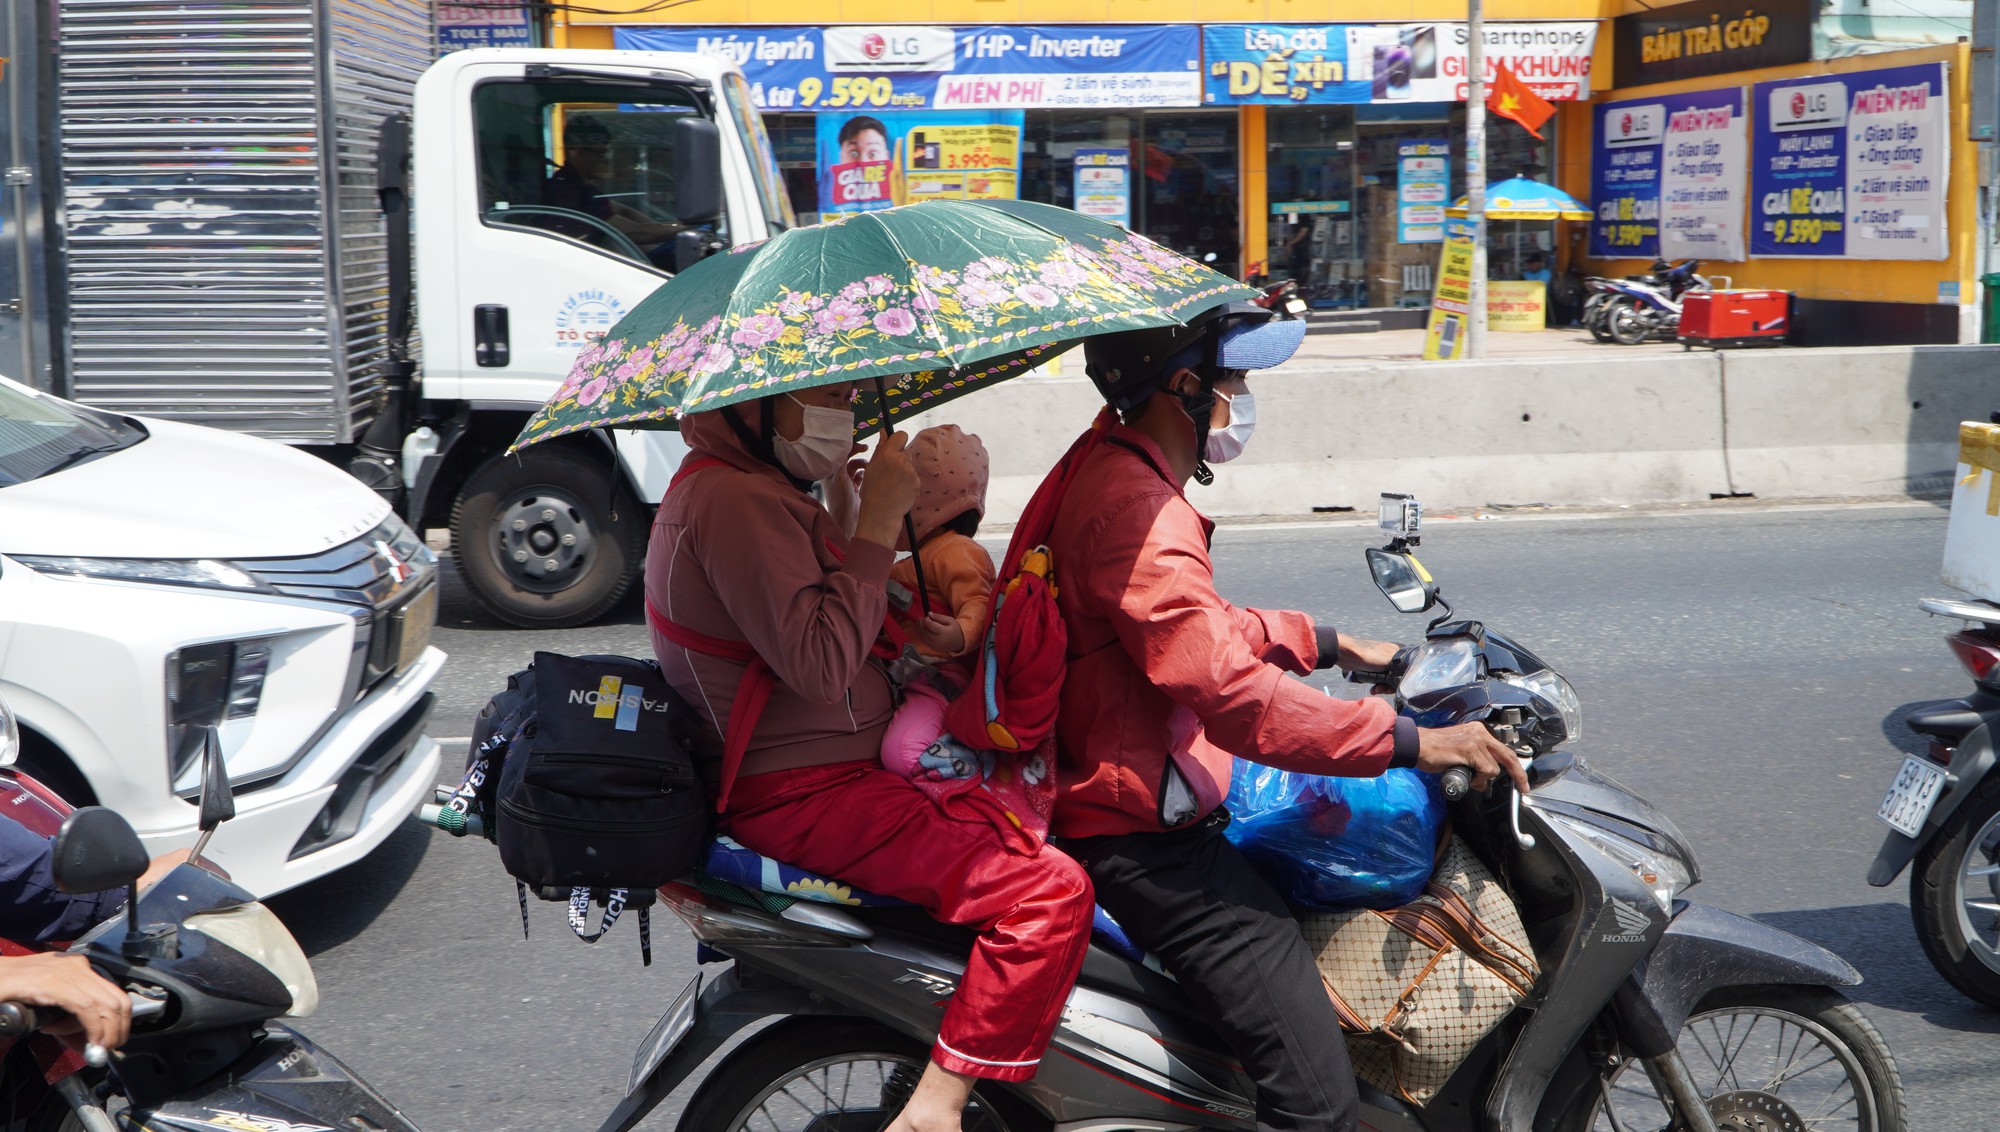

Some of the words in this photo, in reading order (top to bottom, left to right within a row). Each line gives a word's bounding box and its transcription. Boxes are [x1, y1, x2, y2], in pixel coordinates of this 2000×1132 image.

[893, 37, 920, 55] LG
[1244, 28, 1286, 51] Lên
[1289, 27, 1328, 51] đời
[1454, 28, 1586, 49] Sartphone
[1641, 26, 1682, 63] BÁN
[1684, 13, 1723, 56] TRẢ
[1724, 10, 1770, 49] GÓP
[696, 34, 755, 66] Máy
[755, 35, 815, 66] lạnh
[1294, 54, 1344, 89] xịn
[1443, 55, 1502, 77] GIM
[1513, 48, 1592, 77] KHỦNG
[797, 77, 893, 107] 9.590
[891, 92, 926, 108] triệu
[1007, 77, 1045, 103] PHÍ
[1063, 77, 1073, 90] 2
[1075, 76, 1098, 90] lần
[1121, 76, 1153, 90] sinh
[1808, 94, 1827, 113] LG
[1899, 81, 1930, 112] PHÍ
[1634, 114, 1649, 132] LG
[1704, 104, 1732, 130] PHÍ
[1779, 134, 1805, 153] MÁY
[1804, 134, 1835, 154] LẠNH
[1864, 124, 1894, 143] Giao
[1896, 120, 1919, 144] lắp
[947, 153, 990, 169] 3.990
[1676, 142, 1700, 158] Giao
[1703, 138, 1722, 160] lắp
[1866, 143, 1890, 165] Ống
[1893, 141, 1924, 164] đồng
[837, 166, 864, 186] GIÁ
[863, 161, 887, 183] RẺ
[1678, 159, 1697, 177] Ống
[1699, 159, 1724, 176] đồng
[842, 181, 883, 201] QUÁ
[1671, 189, 1678, 202] 2
[1707, 187, 1730, 202] sinh
[1762, 189, 1790, 215] GIÁ
[1790, 181, 1813, 215] RẺ
[1810, 187, 1846, 215] QUÁ
[1861, 178, 1868, 193] 2
[1869, 176, 1888, 193] lần
[1889, 176, 1902, 197] vệ
[1904, 175, 1931, 193] sinh
[1599, 198, 1620, 221] GIÁ
[1619, 192, 1636, 220] RẺ
[1634, 196, 1660, 221] QUÁ
[1607, 225, 1643, 246] 9.590
[1774, 219, 1824, 244] 9.590
[568, 689, 669, 713] FASHION
[450, 769, 486, 814] BAG
[1600, 934, 1647, 943] HONDA
